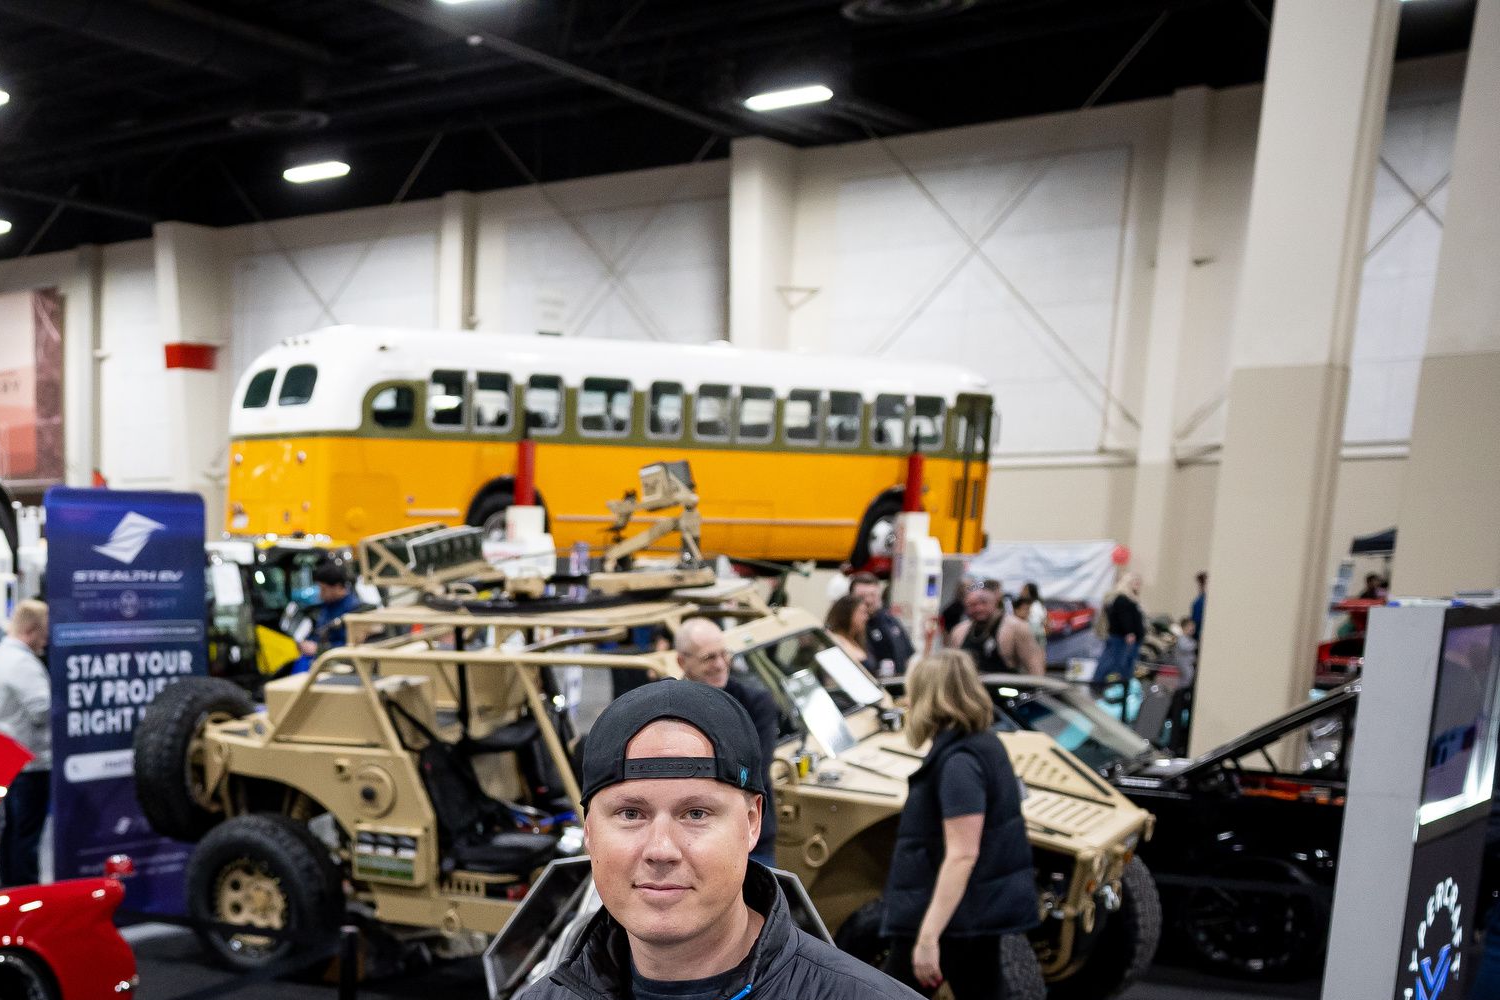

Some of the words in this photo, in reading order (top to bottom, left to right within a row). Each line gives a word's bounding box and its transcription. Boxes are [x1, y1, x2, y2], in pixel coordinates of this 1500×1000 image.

[73, 569, 156, 583] STEALTH
[158, 569, 184, 582] EV
[66, 652, 132, 680] START
[134, 650, 193, 676] YOUR
[67, 682, 97, 709] EV
[67, 706, 134, 738] RIGHT
